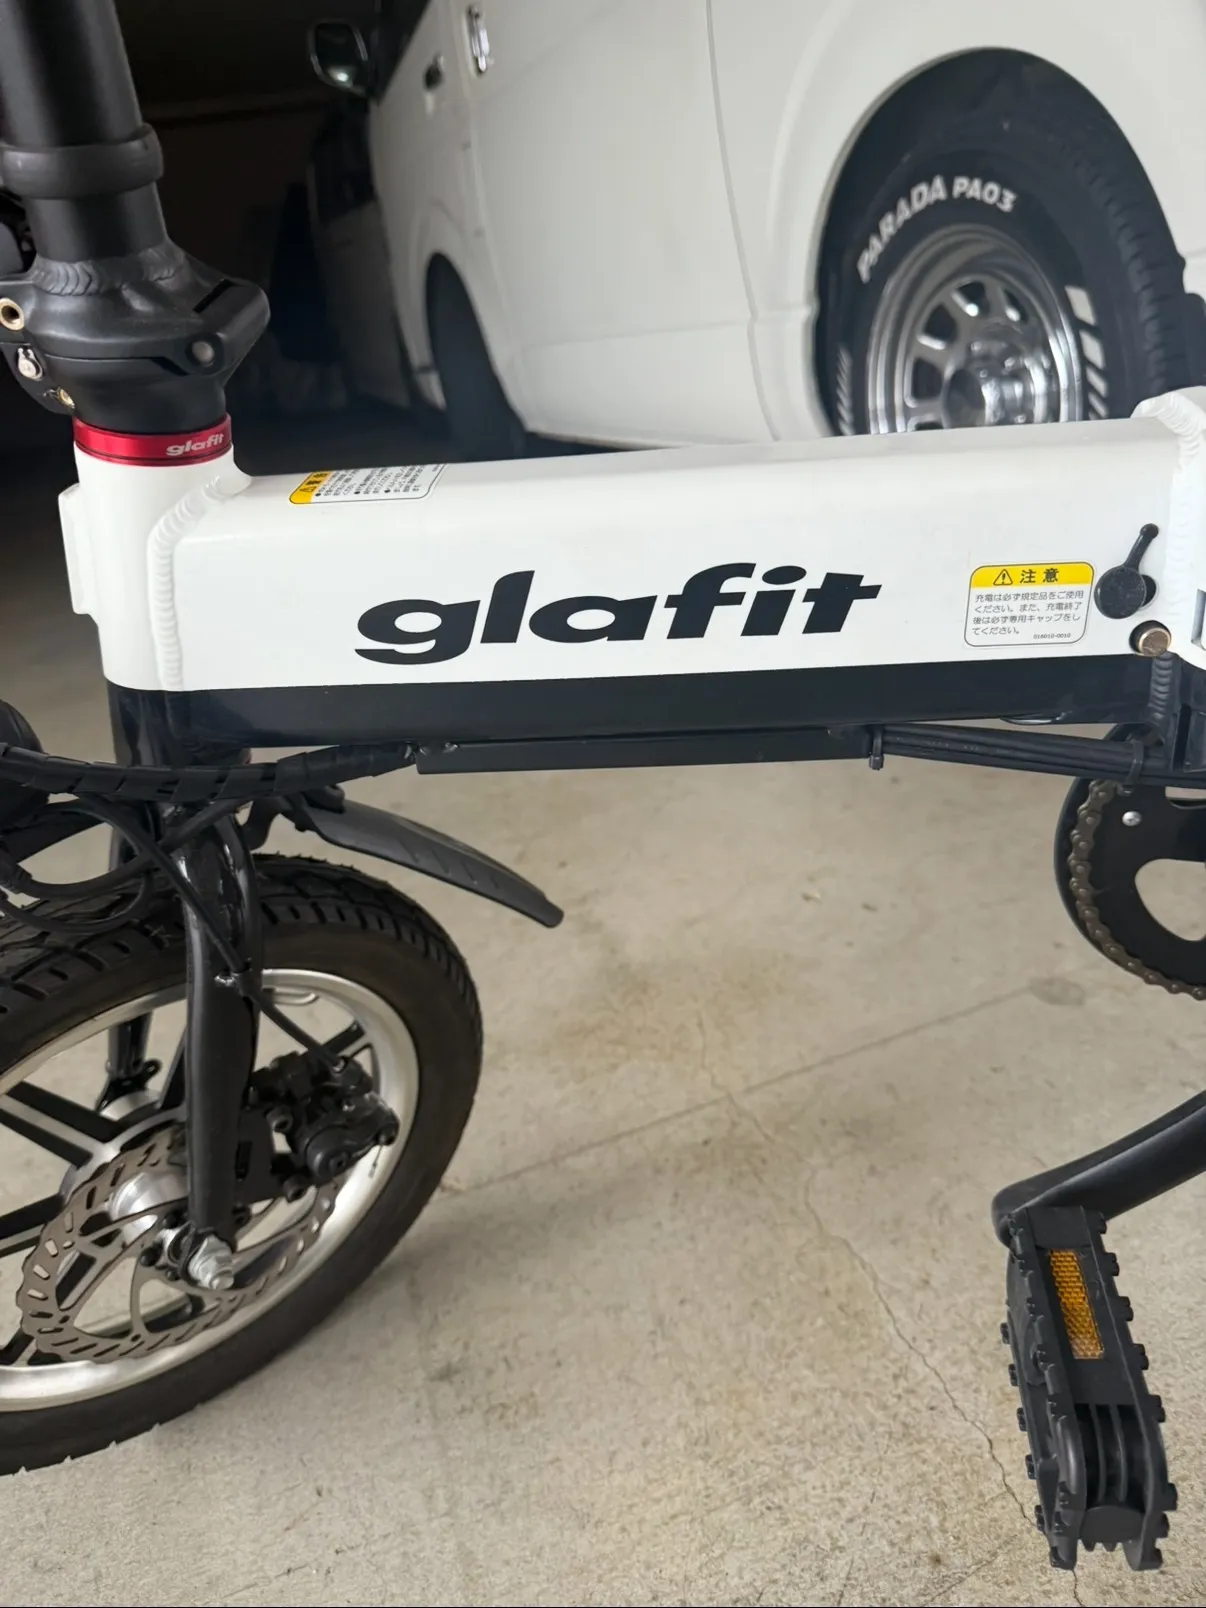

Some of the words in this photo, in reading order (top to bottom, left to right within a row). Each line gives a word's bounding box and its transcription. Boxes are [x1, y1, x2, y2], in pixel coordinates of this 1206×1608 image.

[857, 175, 948, 284] PARADA
[953, 176, 1018, 212] PA03
[165, 432, 224, 456] glafit
[1020, 567, 1059, 584] 注意
[354, 562, 883, 666] glafit
